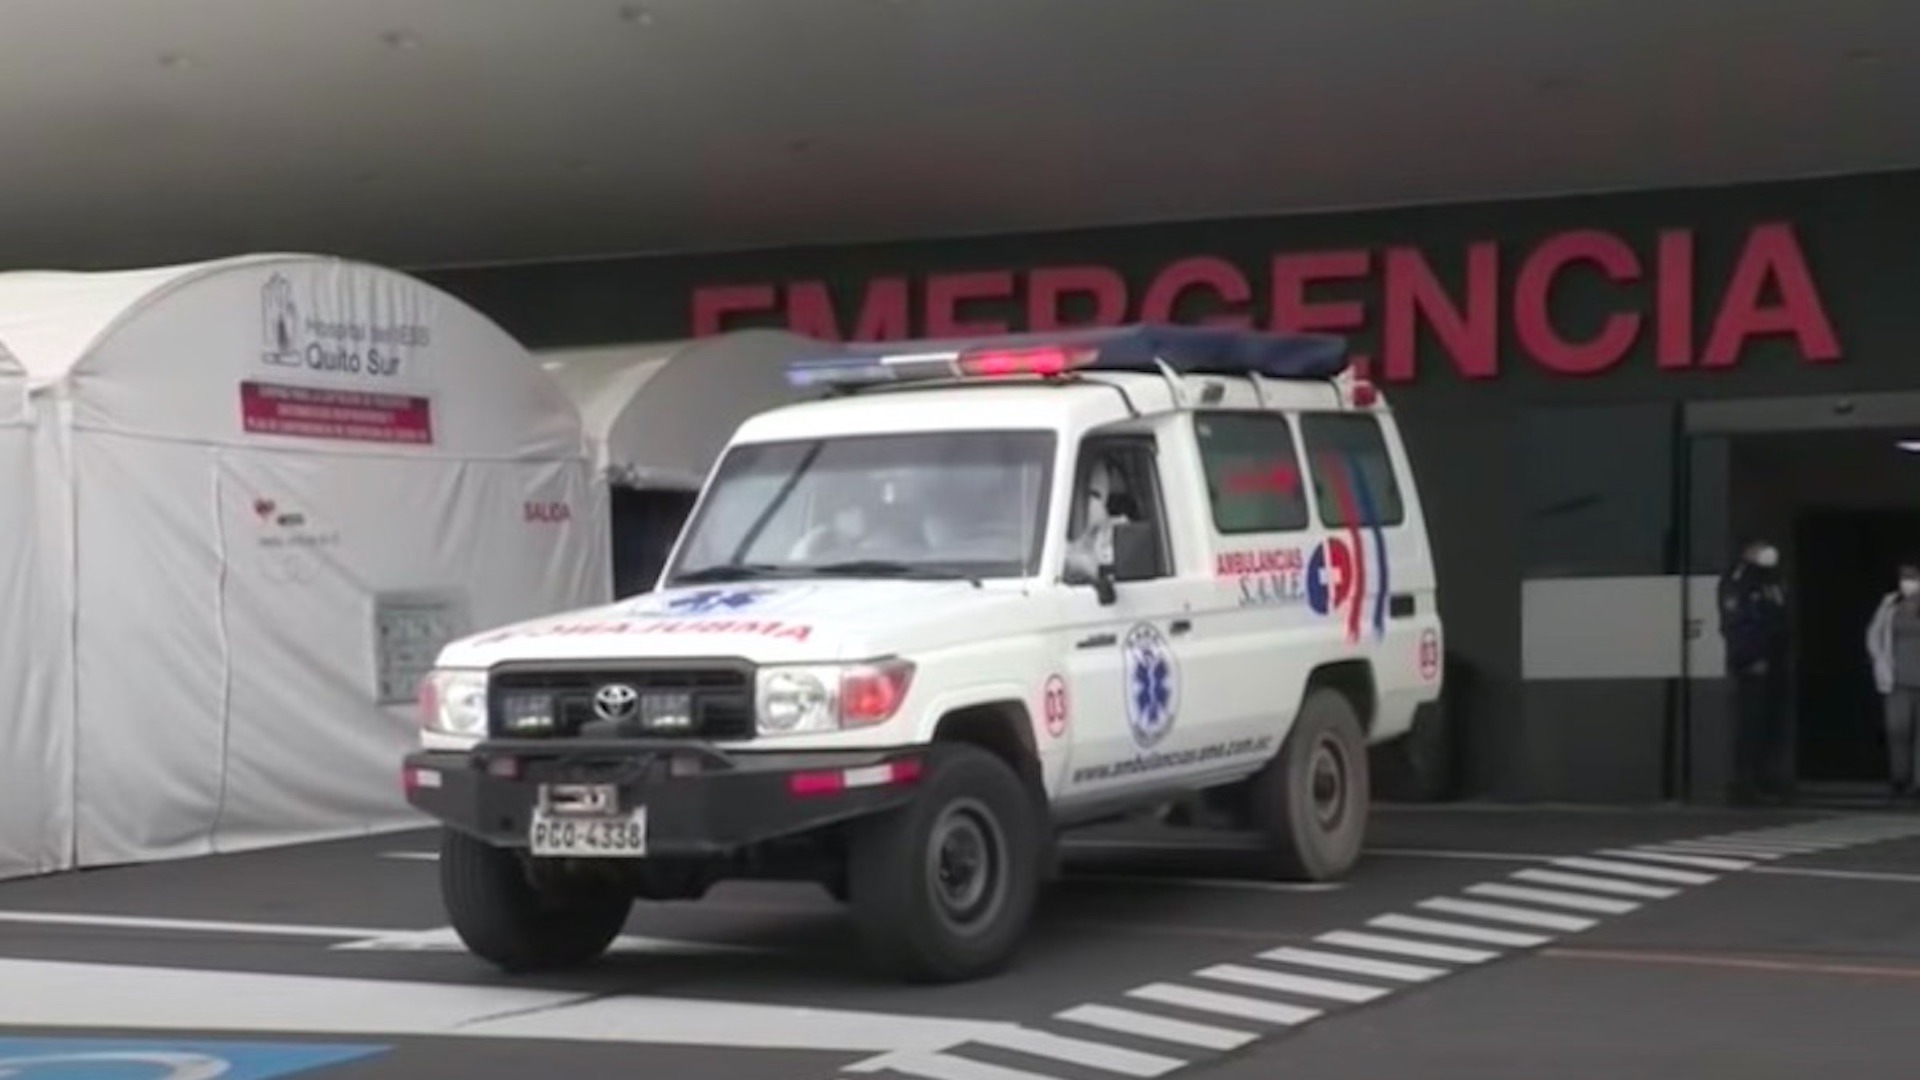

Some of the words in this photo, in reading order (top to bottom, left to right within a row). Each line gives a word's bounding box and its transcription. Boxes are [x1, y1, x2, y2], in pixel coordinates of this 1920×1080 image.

[306, 343, 361, 373] Quito
[367, 347, 400, 376] Sur
[523, 501, 571, 524] SALIDA
[1216, 548, 1304, 577] AMBULANCIAS
[1045, 687, 1066, 723] 03
